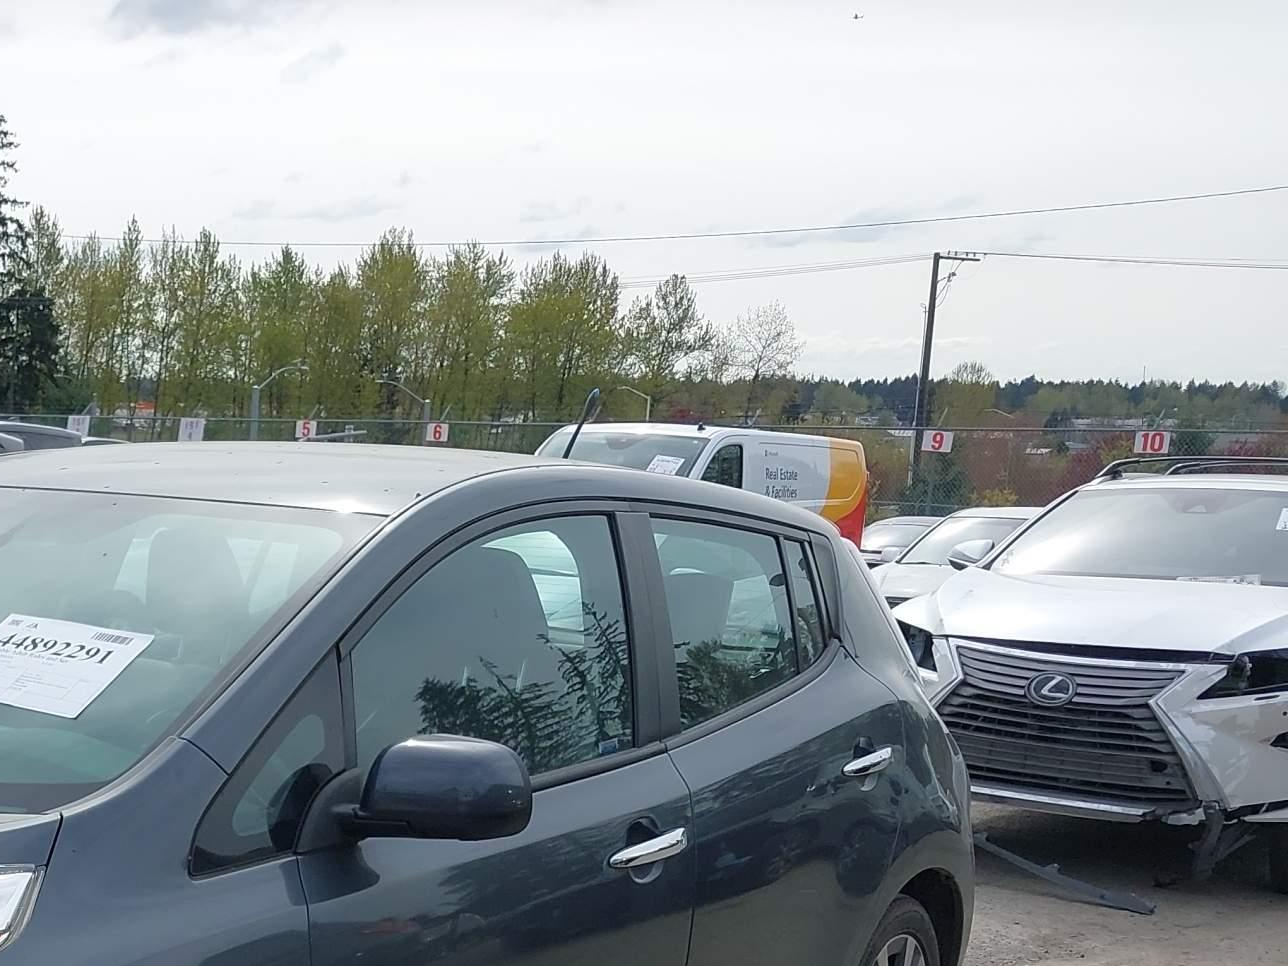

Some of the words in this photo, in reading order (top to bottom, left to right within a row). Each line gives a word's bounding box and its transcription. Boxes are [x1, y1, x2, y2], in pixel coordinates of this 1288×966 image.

[302, 421, 311, 437] 5
[433, 424, 442, 440] 6
[931, 432, 944, 450] 9
[1142, 432, 1165, 452] 10
[765, 467, 779, 480] Real
[779, 467, 798, 481] Estate
[771, 485, 798, 499] Facilities
